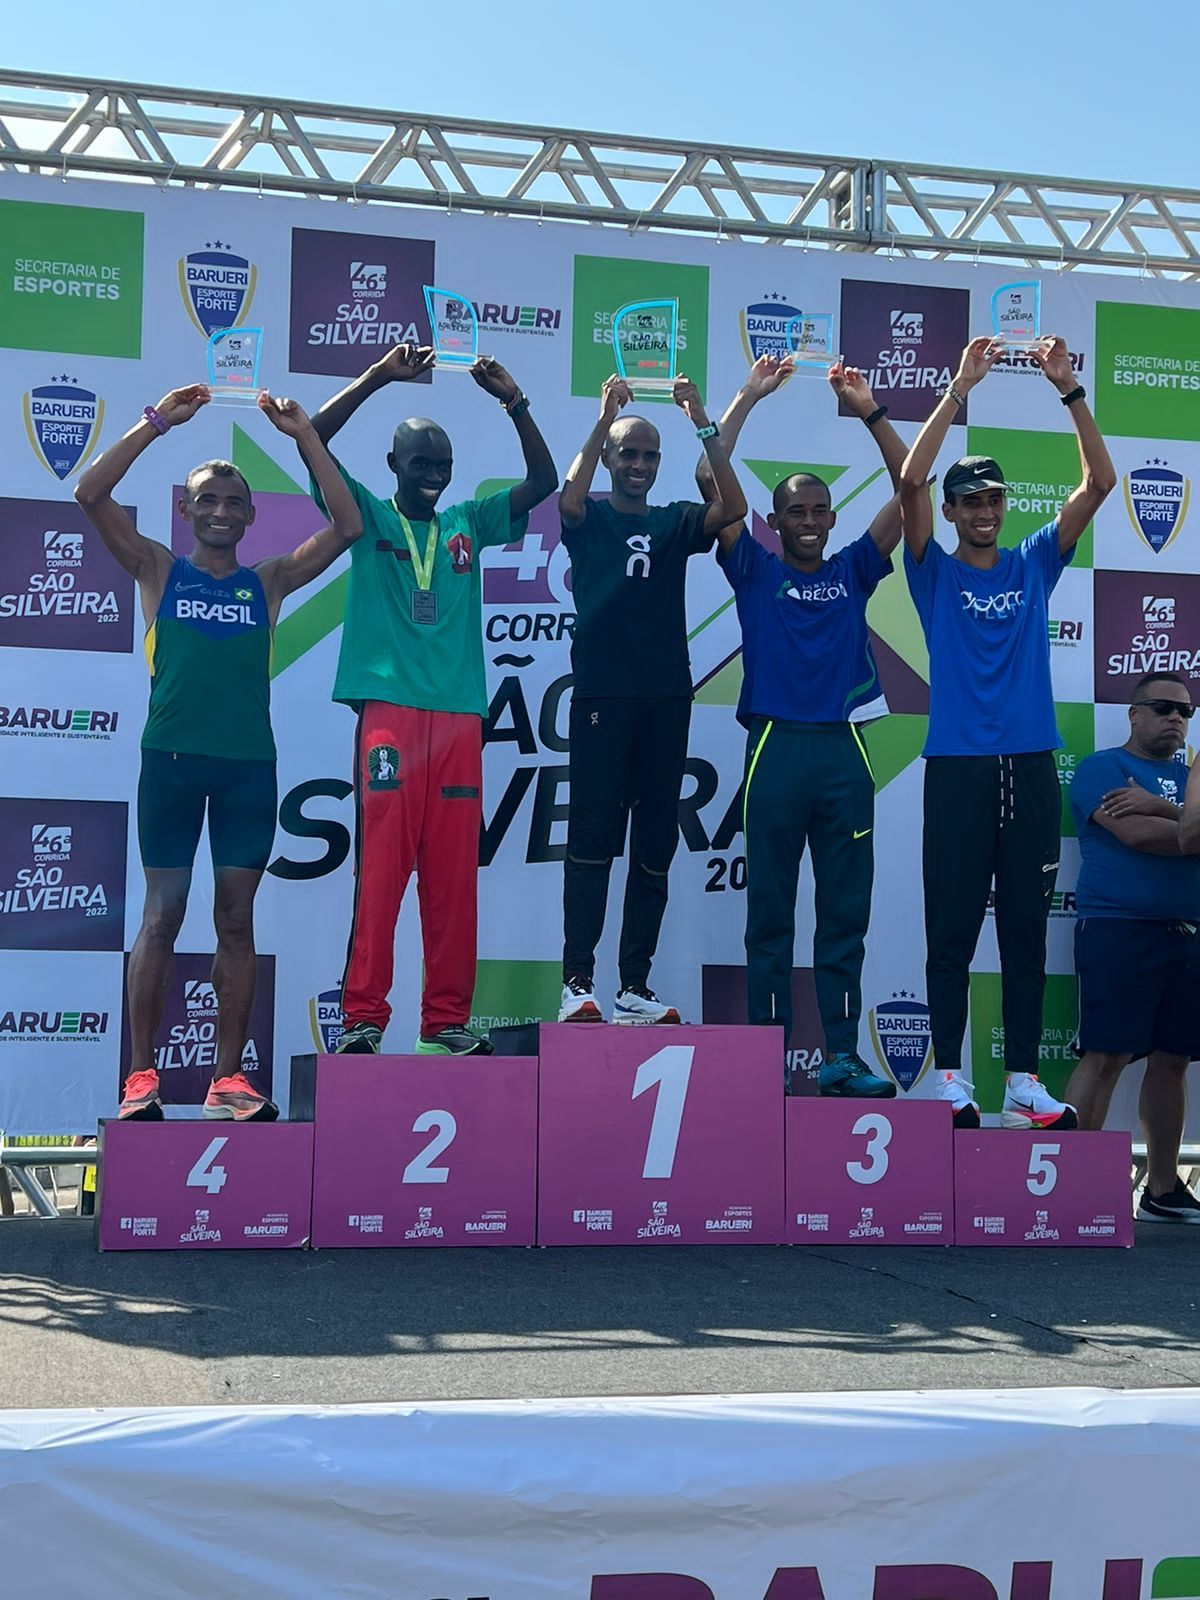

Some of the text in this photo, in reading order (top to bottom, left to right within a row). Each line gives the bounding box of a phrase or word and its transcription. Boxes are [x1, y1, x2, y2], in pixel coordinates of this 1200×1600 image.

[15, 258, 120, 280] SECRETARIA DE
[187, 267, 248, 285] BARUERI
[14, 276, 120, 300] ESPORTES
[197, 288, 237, 299] ESPORTE
[352, 290, 385, 298] CORRIDA
[197, 298, 237, 311] FORTE
[336, 299, 379, 321] SÃO
[446, 299, 561, 329] BARUERI
[308, 322, 420, 345] SILVEIRA
[877, 345, 916, 367] SÃO
[1114, 354, 1200, 372] SECRETARIA DE
[860, 367, 952, 389] ILVEIRA
[1114, 370, 1200, 390] ESPORTES
[32, 402, 95, 419] BARUERI
[42, 422, 84, 434] ESPORTE
[42, 432, 83, 446] FORTE
[1131, 483, 1183, 498] BARUERI
[1007, 497, 1063, 514] PORTE
[1140, 501, 1174, 511] ESPORTE
[1140, 510, 1174, 522] FORTE
[28, 569, 75, 592] SÃO
[0, 591, 119, 617] SILVEIRA
[97, 614, 120, 623] 2022
[176, 599, 257, 626] BRASIL
[1131, 631, 1169, 652] SÃO
[1060, 754, 1076, 767] DE
[34, 854, 70, 862] CORRIDA
[15, 863, 63, 888] SÃO
[86, 907, 108, 917] 2022
[184, 980, 219, 1009] 46
[187, 1009, 218, 1017] CORRID
[0, 1011, 109, 1033] ARUERI
[472, 1016, 520, 1028] RETARIA
[877, 1018, 929, 1031] BARUER
[168, 1019, 215, 1044] SÃO
[887, 1037, 923, 1046] ESPORTE
[887, 1045, 923, 1057] FORTE
[242, 1062, 259, 1071] 022
[631, 1045, 696, 1179] 1
[402, 1109, 458, 1184] 2
[846, 1113, 894, 1185] 3
[186, 1137, 230, 1194] 4
[1026, 1143, 1061, 1196] 5
[465, 1222, 506, 1231] BARUERI
[587, 1222, 612, 1230] FORTE
[648, 1217, 665, 1226] SÃO
[705, 1220, 752, 1230] BARUERI
[808, 1223, 828, 1231] FORTE
[904, 1223, 942, 1231] BARUERI
[133, 1228, 157, 1236] FORTE
[190, 1224, 206, 1233] SÃO
[244, 1226, 288, 1235] BARUERI
[404, 1226, 444, 1239] SILVEIRA
[637, 1224, 681, 1238] SILVEIRA
[849, 1226, 885, 1238] SILVEIRA
[984, 1226, 1005, 1234] FORTE
[1024, 1229, 1059, 1240] SILVEIRA
[179, 1230, 221, 1242] SILVEIRA
